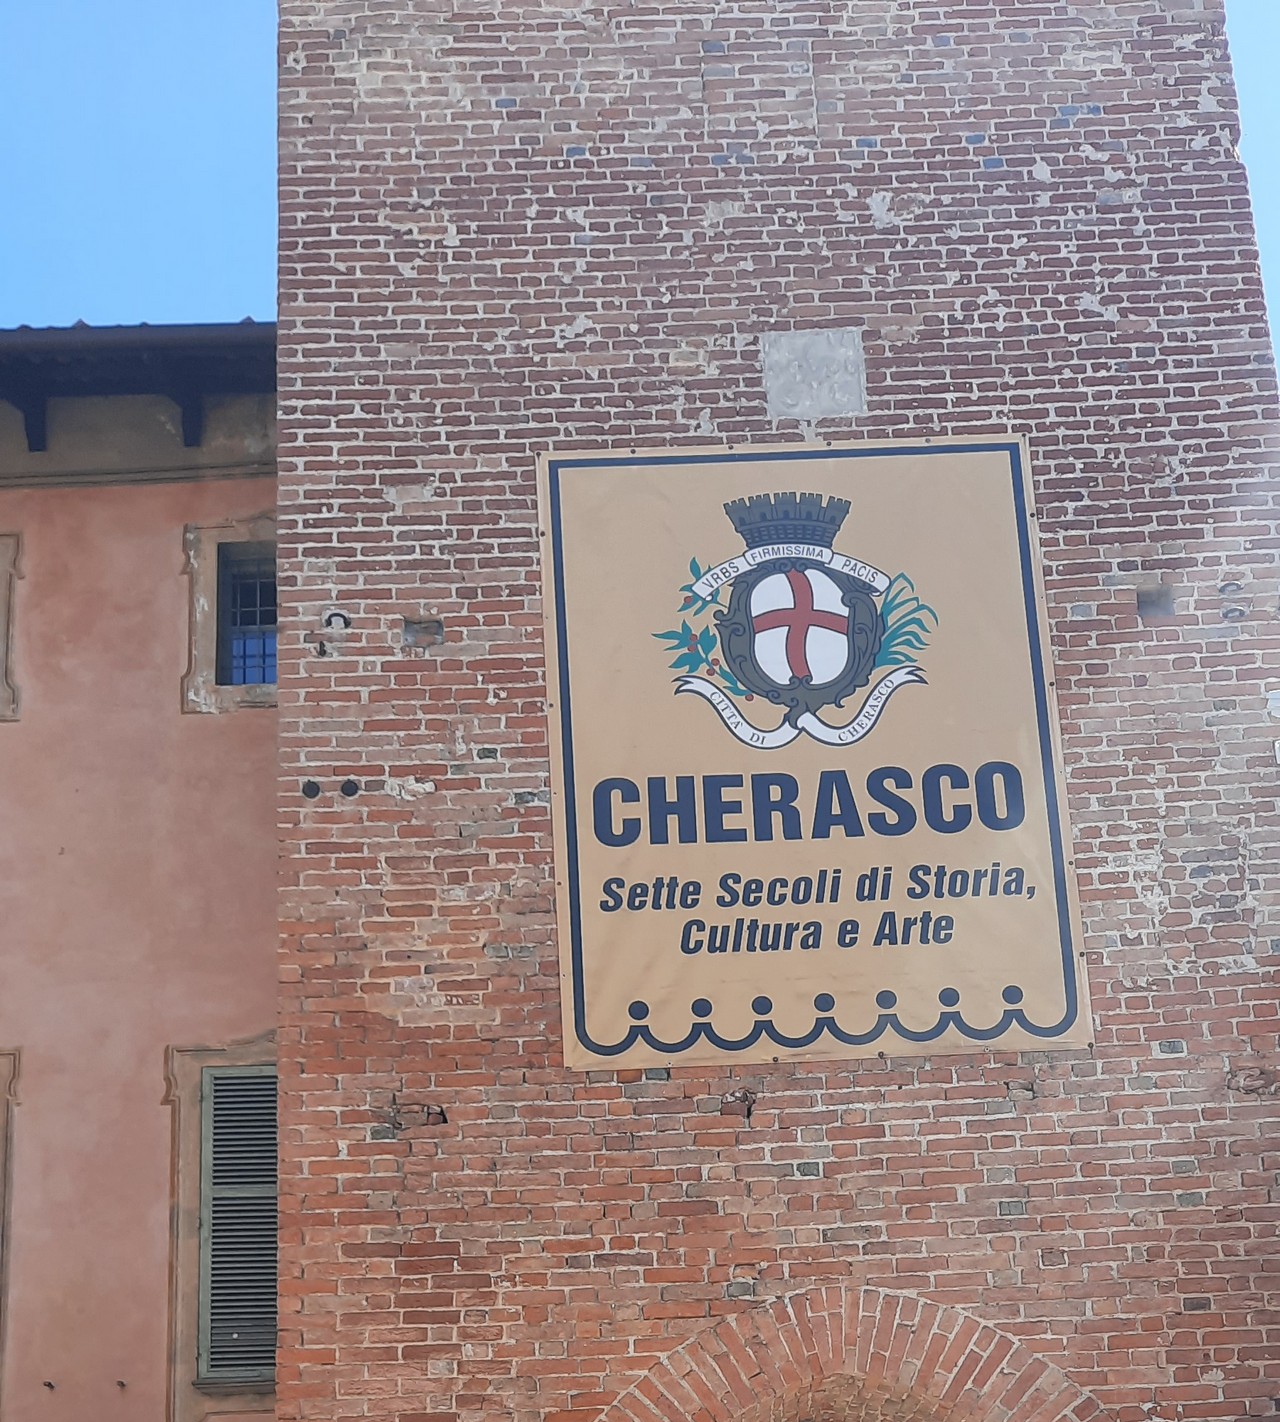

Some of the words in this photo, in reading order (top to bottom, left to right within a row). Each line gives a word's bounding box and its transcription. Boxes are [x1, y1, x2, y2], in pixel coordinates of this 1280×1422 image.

[702, 561, 740, 590] VRBS
[750, 545, 824, 563] FIRMISSIMA
[841, 558, 878, 584] PACIS
[749, 732, 766, 745] DI
[838, 678, 895, 742] CHERASCO
[592, 761, 1026, 848] CHERASCO
[599, 875, 703, 913] Sette
[716, 867, 842, 909] Secoli
[855, 865, 893, 902] di
[906, 862, 1037, 900] Storia,
[679, 917, 823, 955] Cultura
[837, 918, 860, 949] e
[872, 909, 956, 947] Arte
